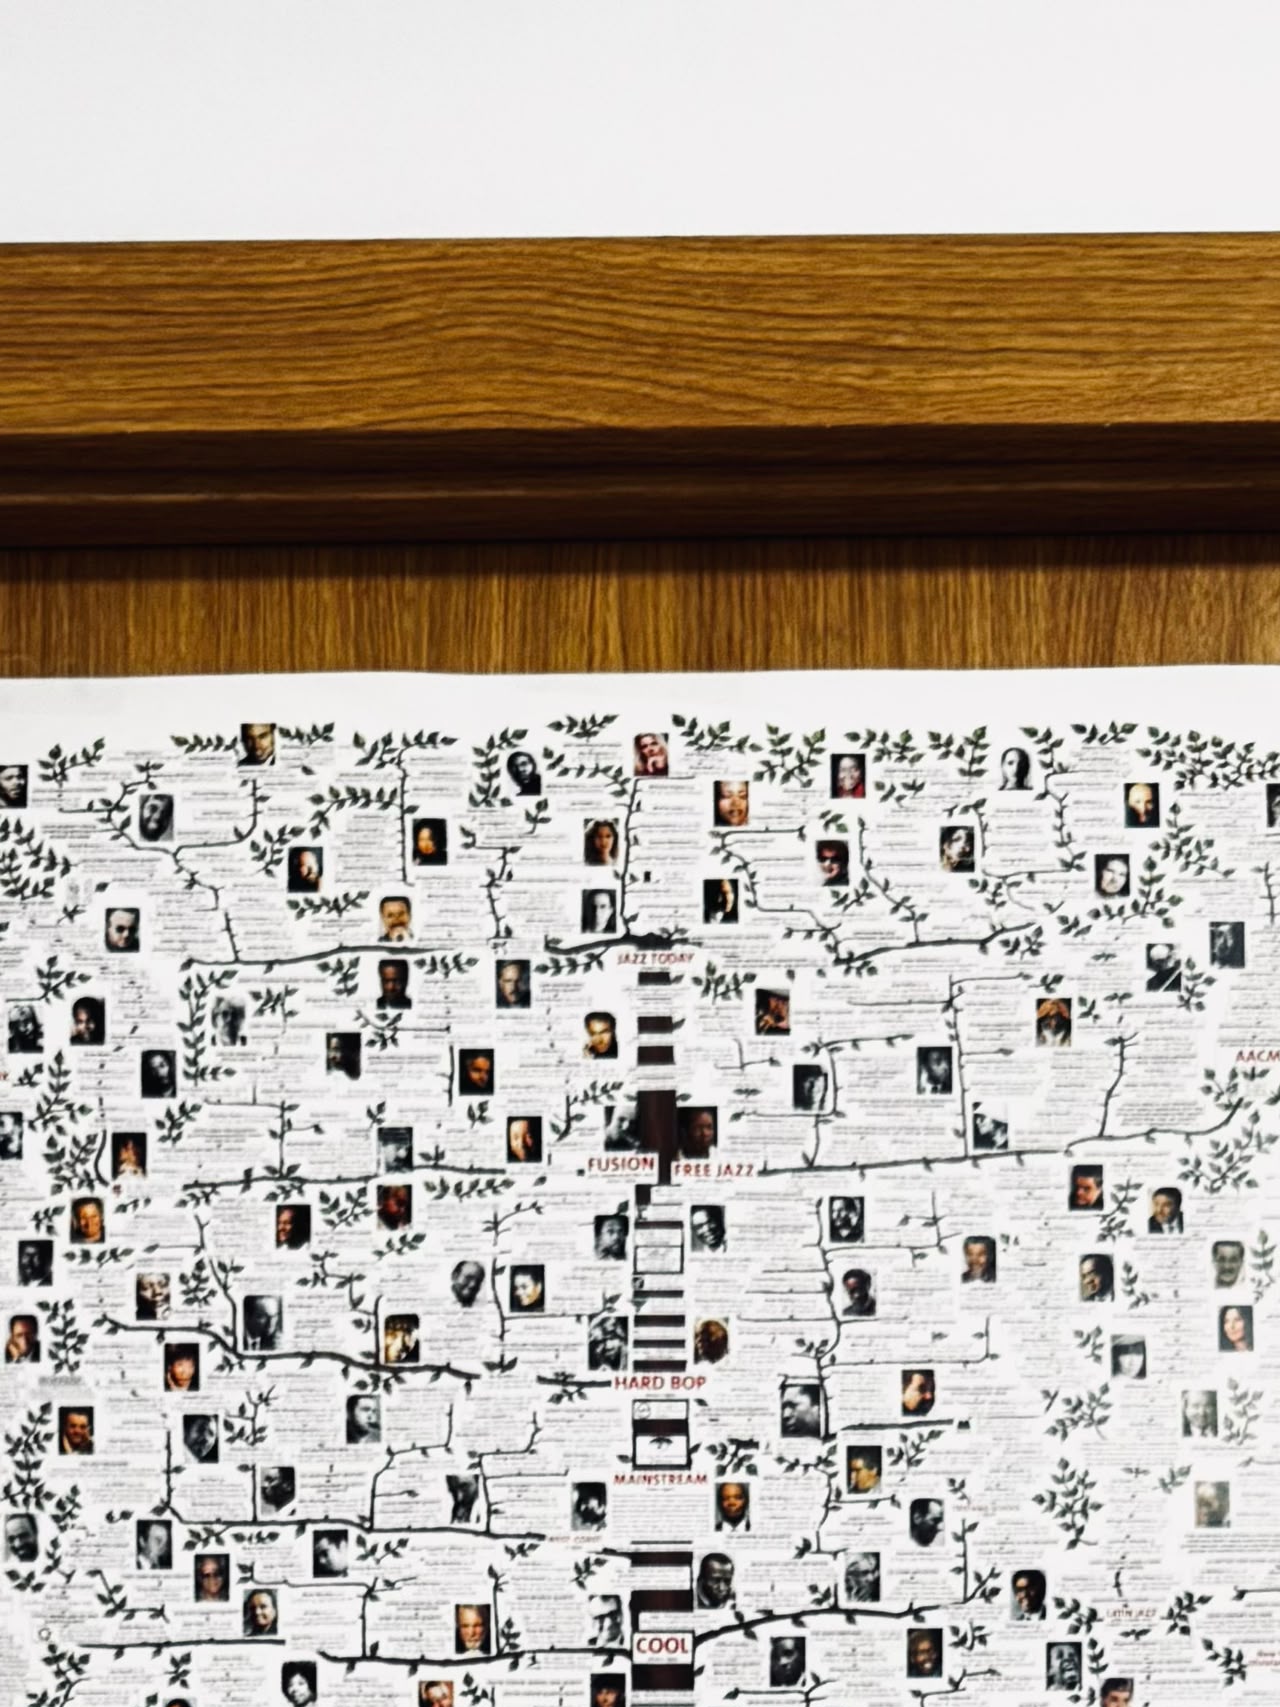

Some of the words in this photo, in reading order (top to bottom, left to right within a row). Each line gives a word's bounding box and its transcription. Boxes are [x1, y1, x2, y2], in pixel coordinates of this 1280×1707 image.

[1236, 1050, 1280, 1062] AACM
[588, 1157, 654, 1171] FUSION
[675, 1164, 710, 1176] FREE
[717, 1164, 753, 1177] JAZZ
[615, 1376, 664, 1390] HARD
[671, 1376, 706, 1390] BOP
[615, 1473, 707, 1486] MAINSTREAM
[636, 1637, 688, 1653] COOL
